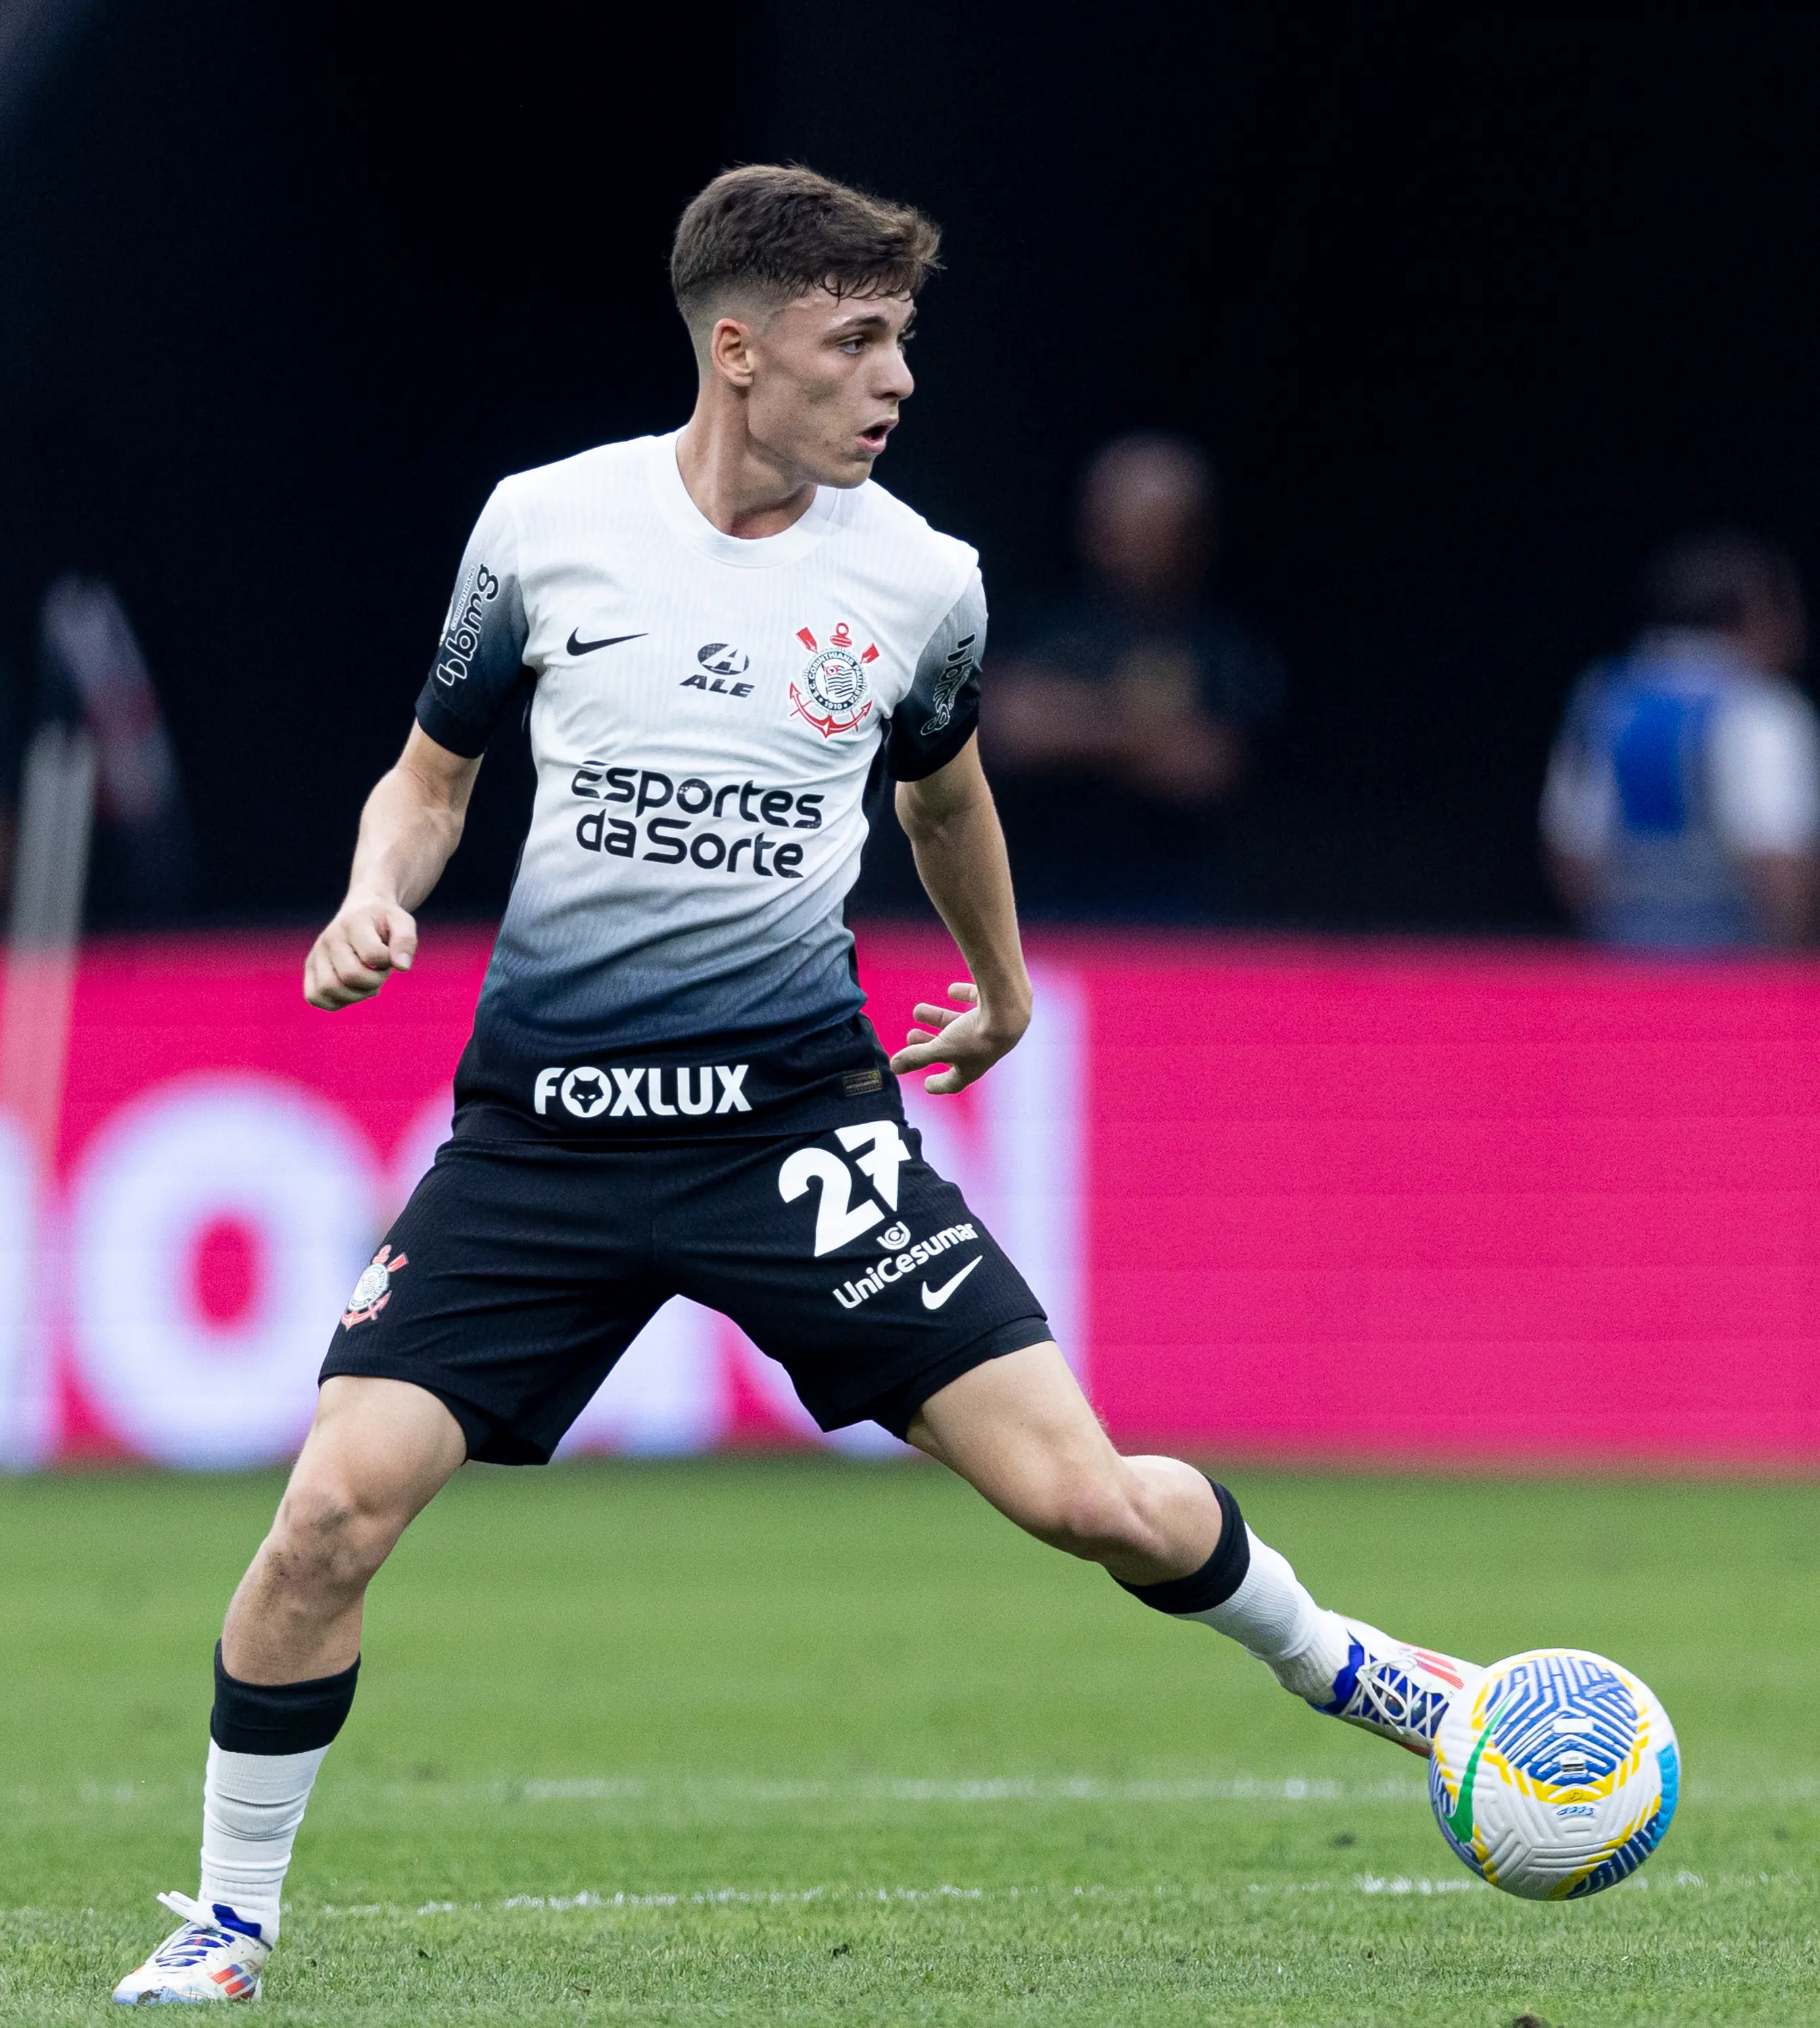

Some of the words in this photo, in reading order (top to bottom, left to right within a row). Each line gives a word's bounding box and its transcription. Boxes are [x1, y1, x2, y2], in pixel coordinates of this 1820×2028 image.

[446, 562, 500, 662] bmg
[678, 674, 756, 698] ALE
[809, 652, 855, 680] CORINTHIANS
[824, 701, 843, 709] 1910
[576, 808, 638, 859] da
[642, 817, 805, 879] Sorte
[534, 1065, 752, 1117] FOXLUX
[778, 1120, 911, 1257] 27
[832, 1223, 979, 1303] UniCesumar
